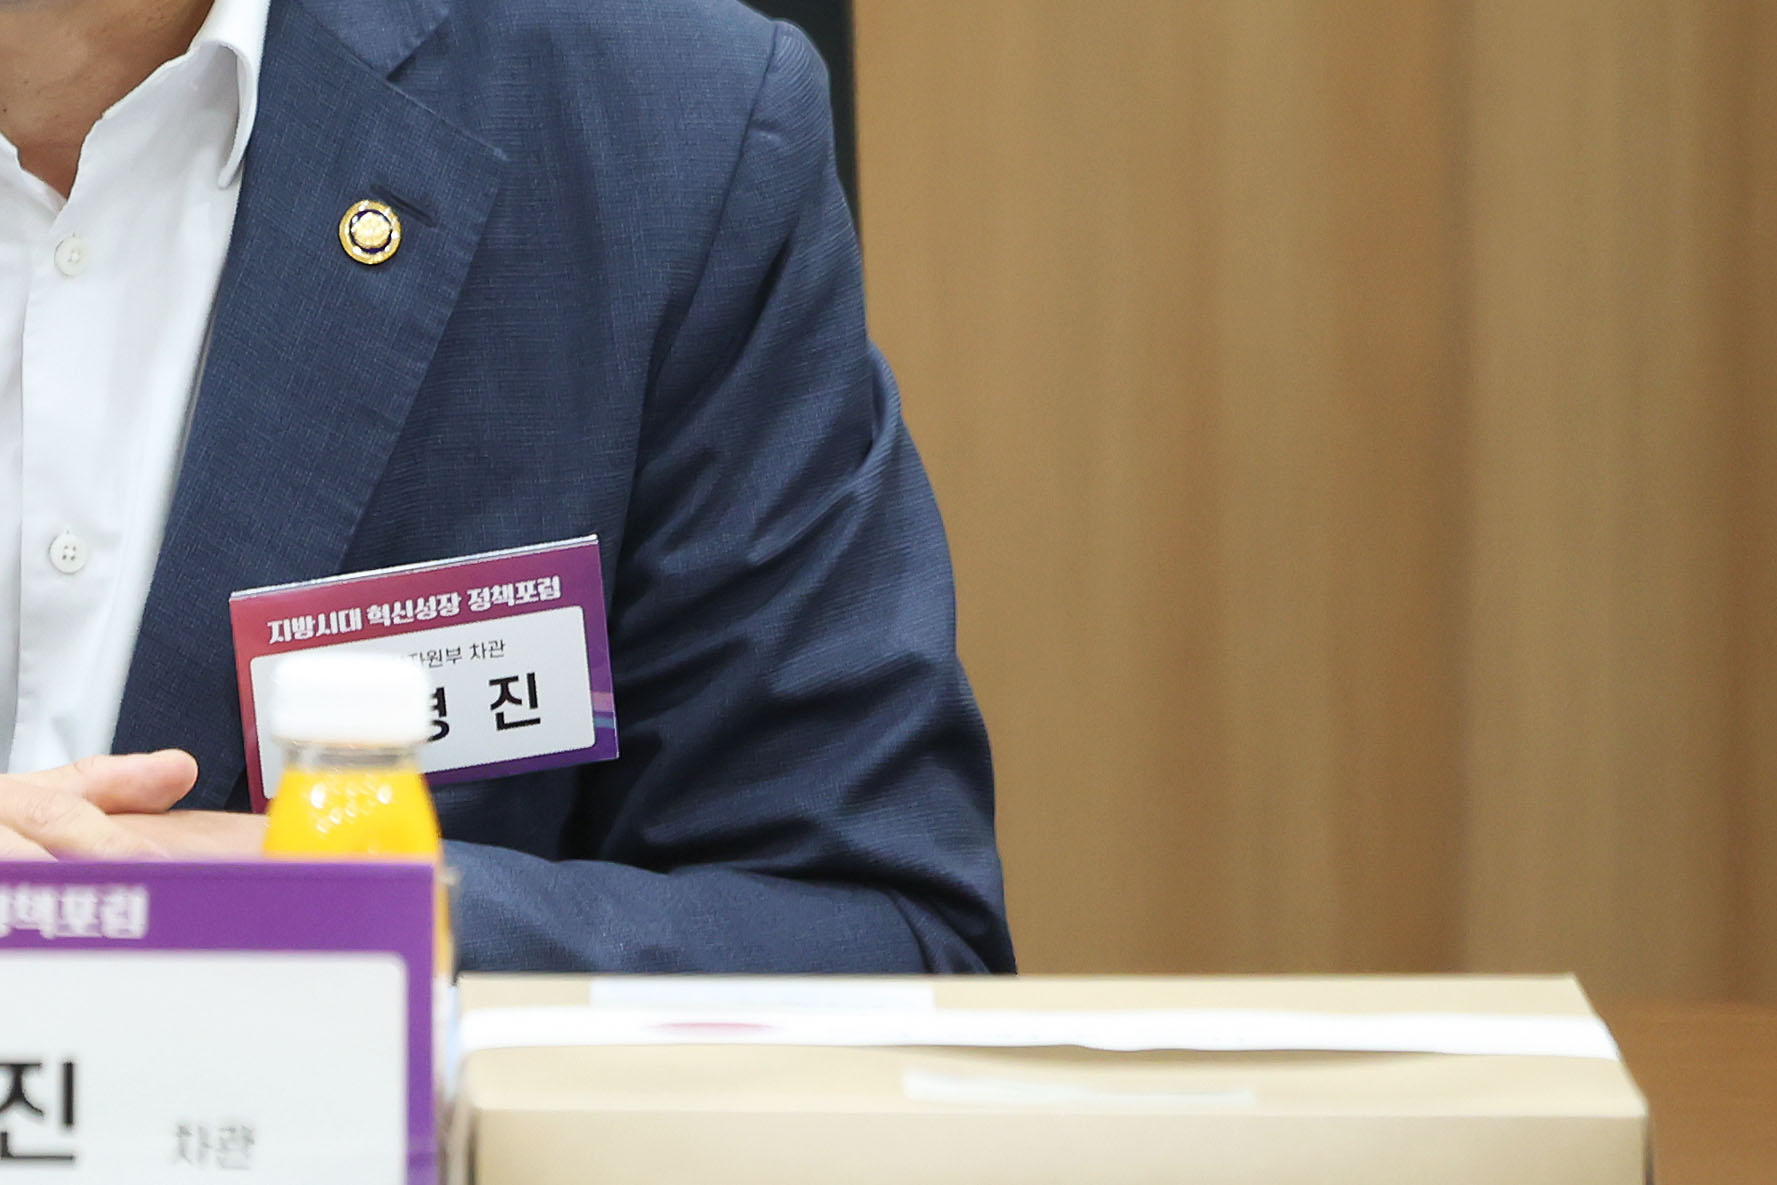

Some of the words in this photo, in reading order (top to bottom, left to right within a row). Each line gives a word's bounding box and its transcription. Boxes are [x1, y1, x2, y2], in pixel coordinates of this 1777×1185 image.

[267, 607, 363, 644] 지방시대
[366, 591, 462, 627] 혁신성장
[467, 575, 561, 611] 정책포럼
[469, 638, 506, 661] 차관
[173, 1122, 257, 1171] 차관
